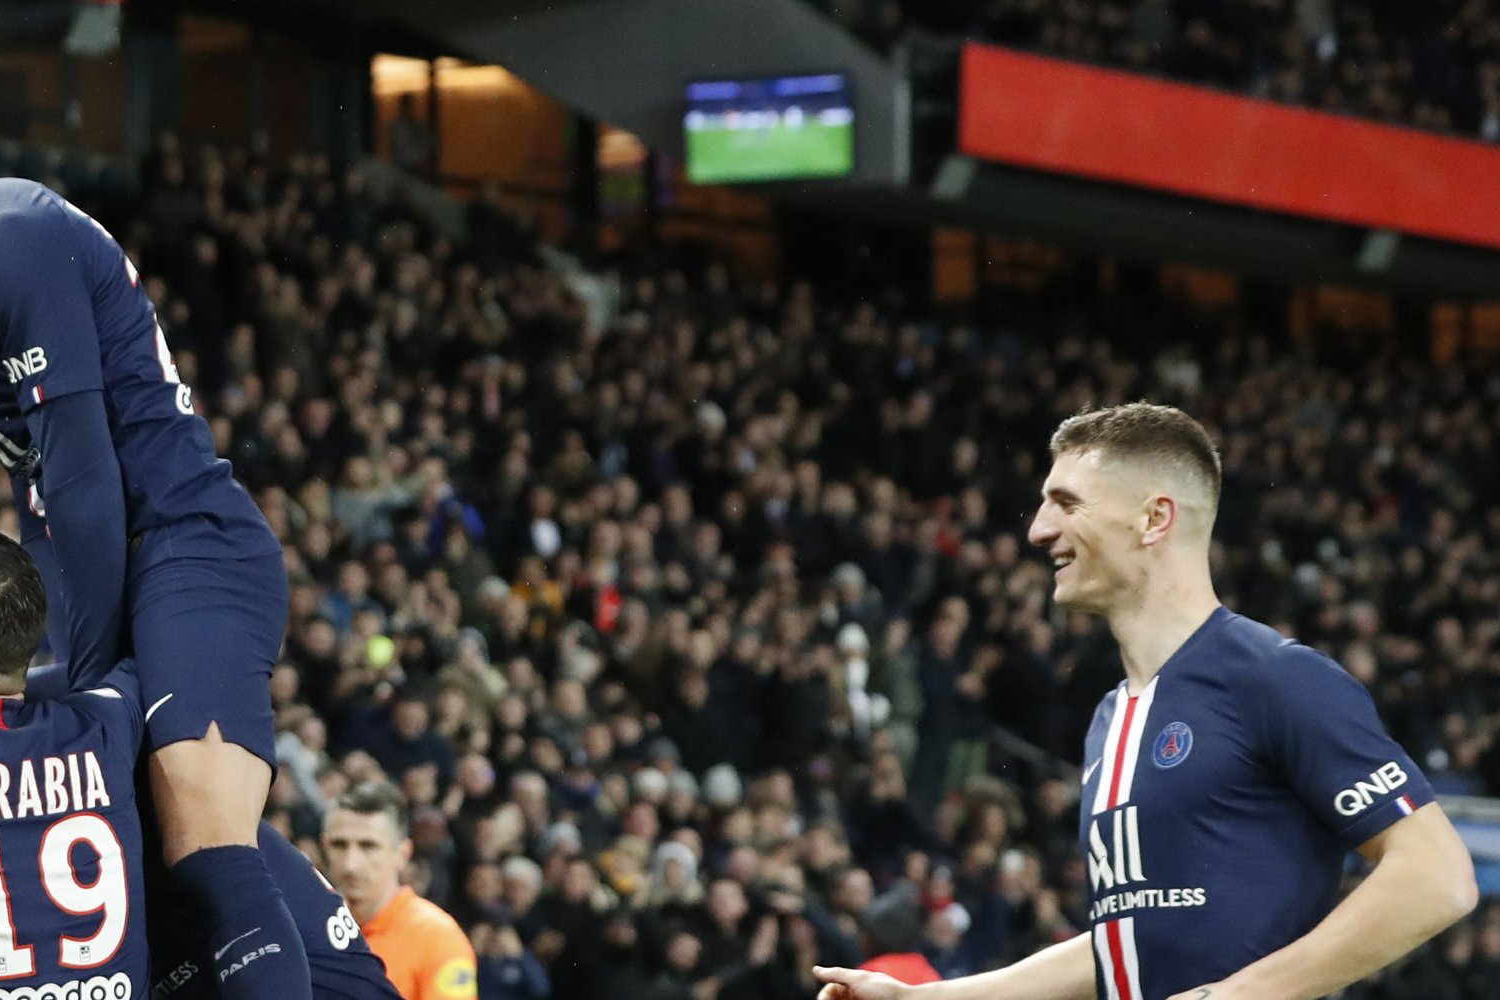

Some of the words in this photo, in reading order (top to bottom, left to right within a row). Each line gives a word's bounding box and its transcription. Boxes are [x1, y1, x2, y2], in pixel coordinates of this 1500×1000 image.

[1334, 761, 1408, 816] QNB
[1118, 887, 1207, 911] LIMITLESS
[220, 943, 281, 982] PARIS
